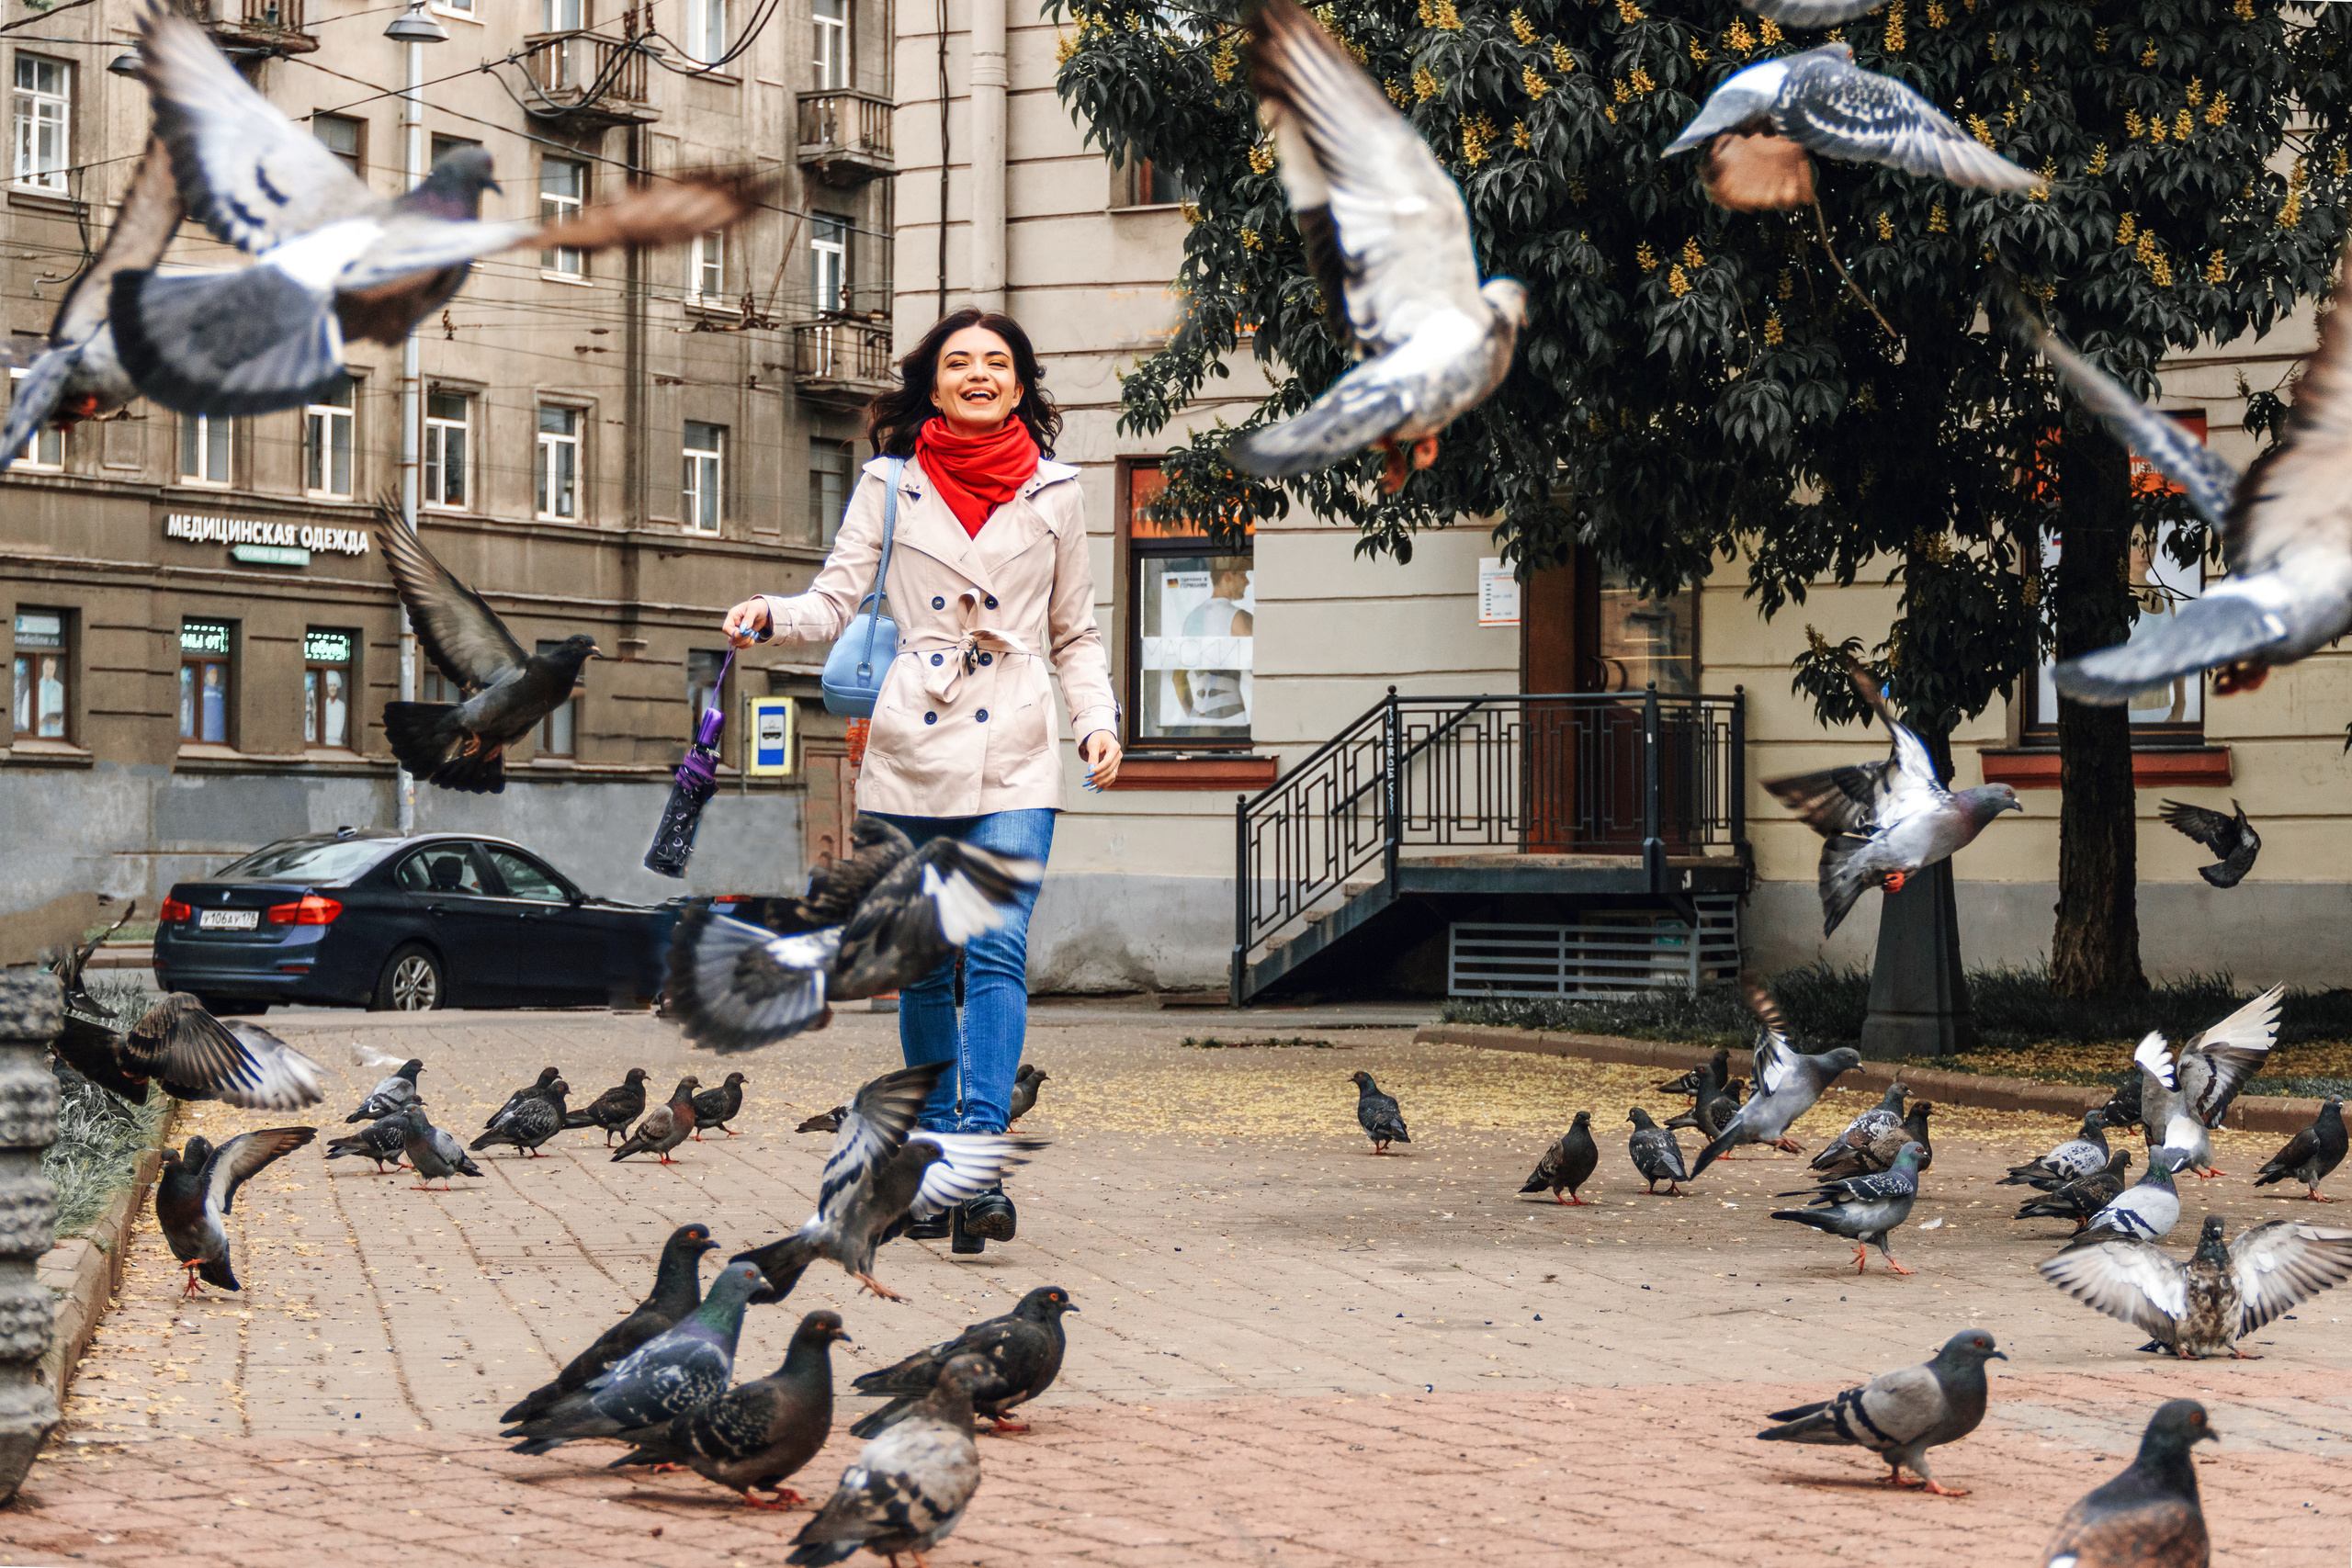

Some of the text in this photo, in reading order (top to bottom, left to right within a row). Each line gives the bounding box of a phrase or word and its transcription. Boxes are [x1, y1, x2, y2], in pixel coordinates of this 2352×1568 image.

[167, 513, 369, 555] МЕДИЦИНСКАЯ ОДЕЖДА
[1142, 638, 1241, 668] МАСКИ
